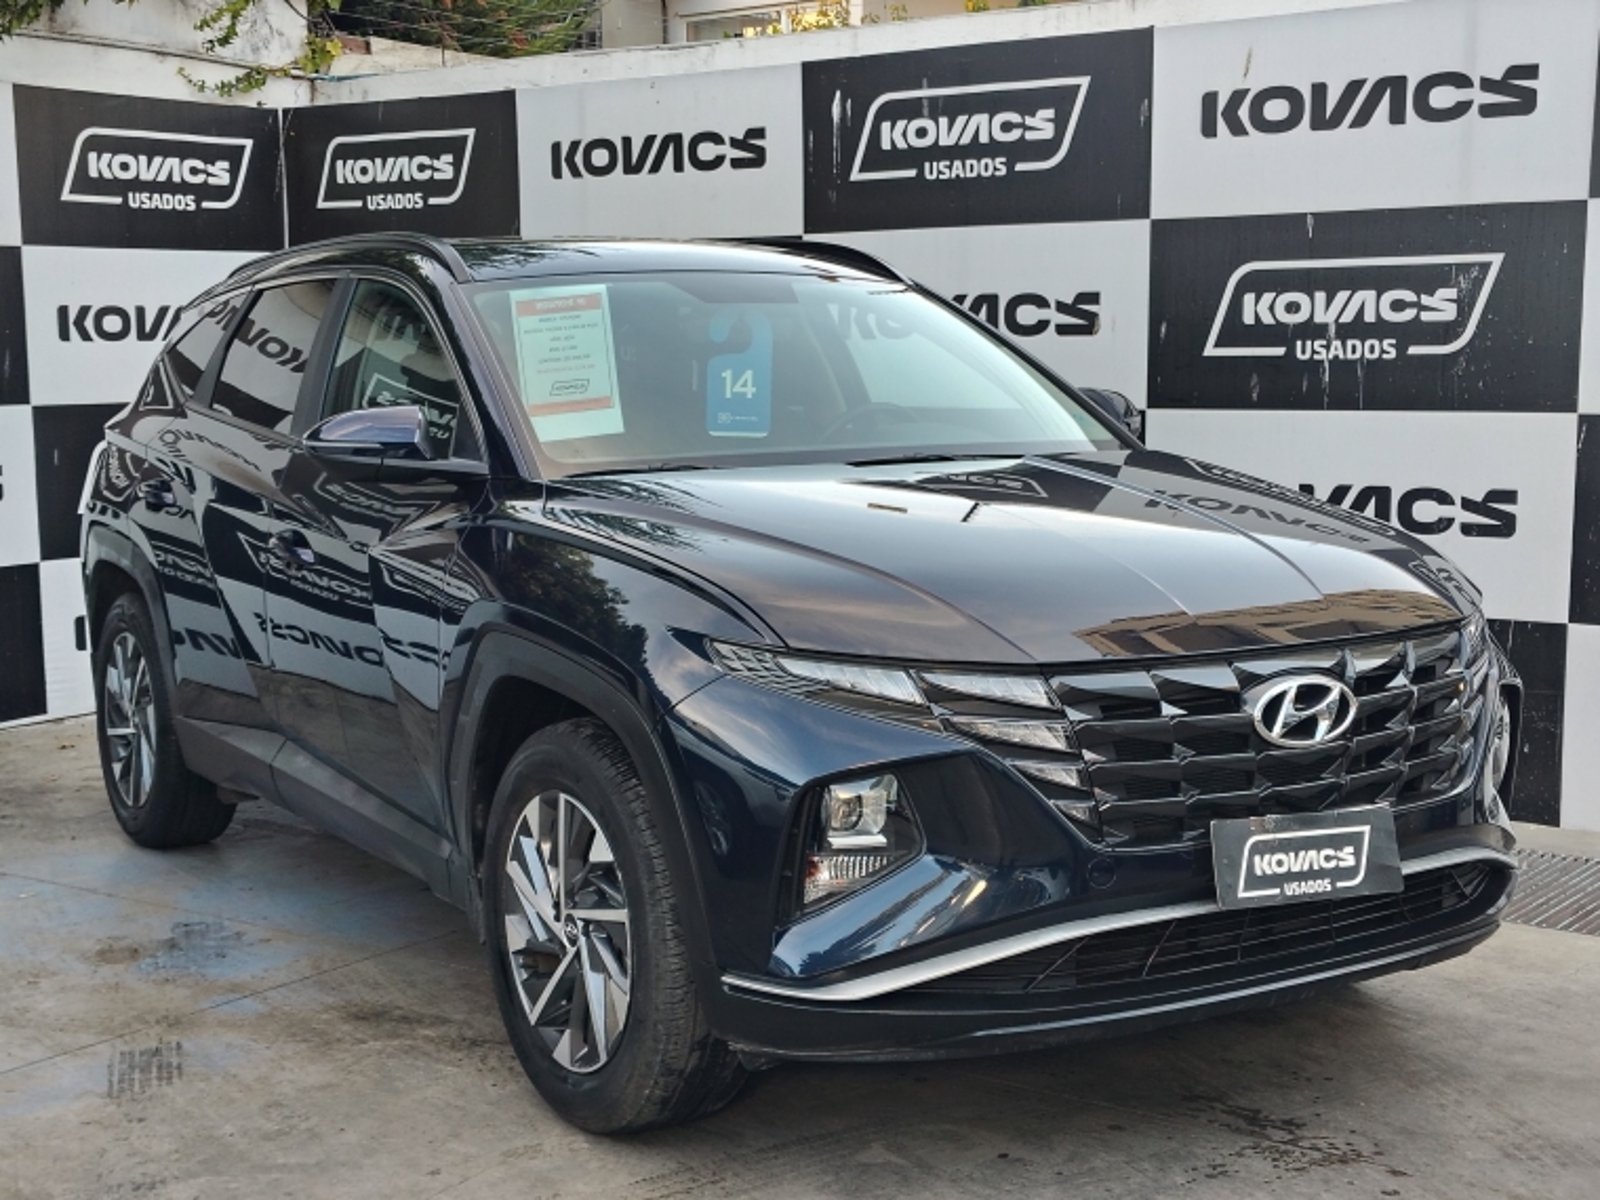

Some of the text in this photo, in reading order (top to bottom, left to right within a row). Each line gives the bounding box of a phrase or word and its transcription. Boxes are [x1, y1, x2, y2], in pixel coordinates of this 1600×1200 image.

[1200, 63, 1540, 139] KOVACS
[880, 107, 1057, 151] KOVACS
[87, 150, 231, 186] KOVACS
[335, 153, 454, 184] KOVACS
[550, 126, 767, 180] KOVACS
[924, 157, 1007, 180] USADOS
[127, 191, 197, 212] USADOS
[366, 192, 424, 211] USADOS
[1242, 287, 1459, 326] KOVACS
[56, 304, 183, 342] KOV
[1295, 338, 1397, 361] USADOS
[720, 368, 757, 399] 14
[1253, 845, 1356, 877] KOVACS
[1283, 878, 1332, 896] USADOS
